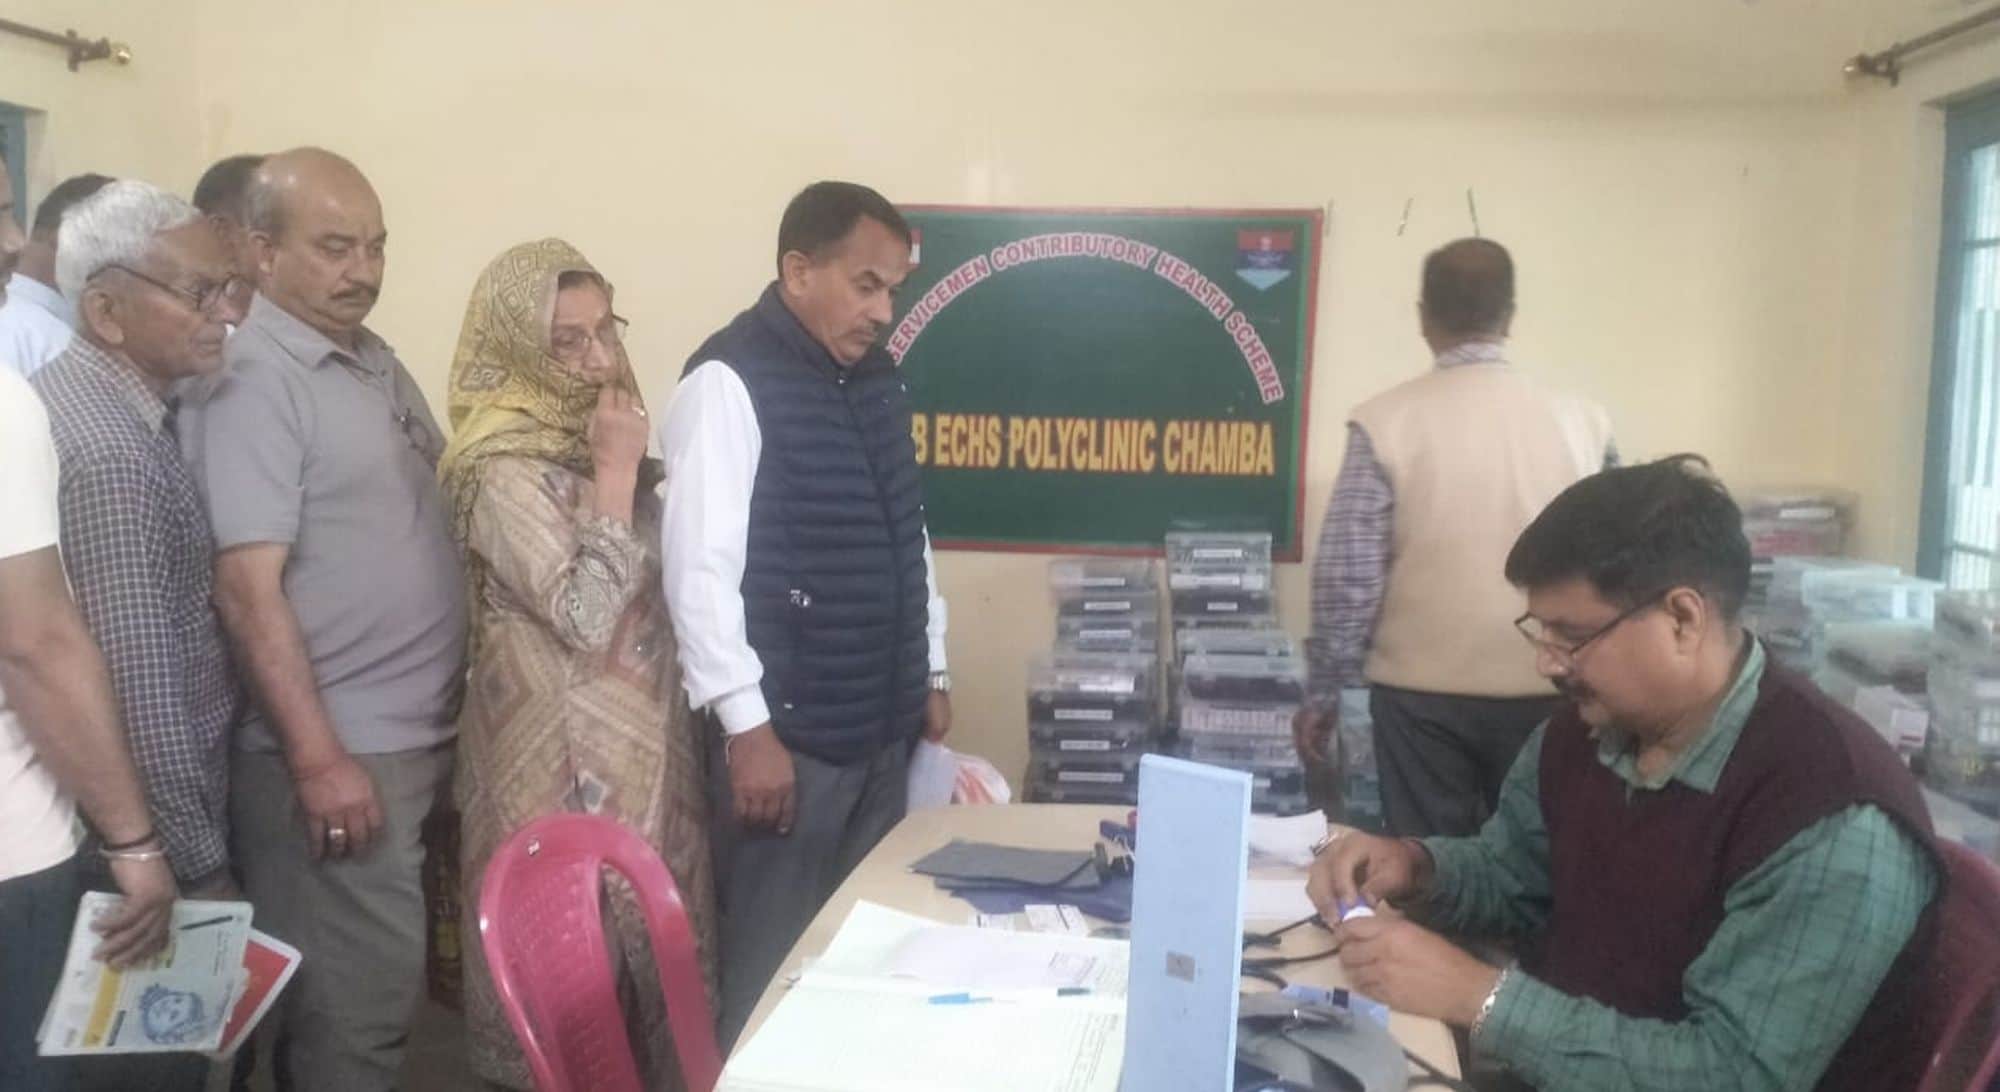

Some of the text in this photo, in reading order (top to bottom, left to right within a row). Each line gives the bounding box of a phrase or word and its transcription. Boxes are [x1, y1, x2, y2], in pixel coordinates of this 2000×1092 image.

[991, 232, 1158, 271] CONTRIBUTORY
[1155, 251, 1234, 321] HEALTH
[1225, 310, 1284, 404] SCHEME
[934, 412, 1002, 469] ECHS
[1007, 416, 1157, 473] POLYCLINIC
[1162, 420, 1276, 477] CHAMBA
